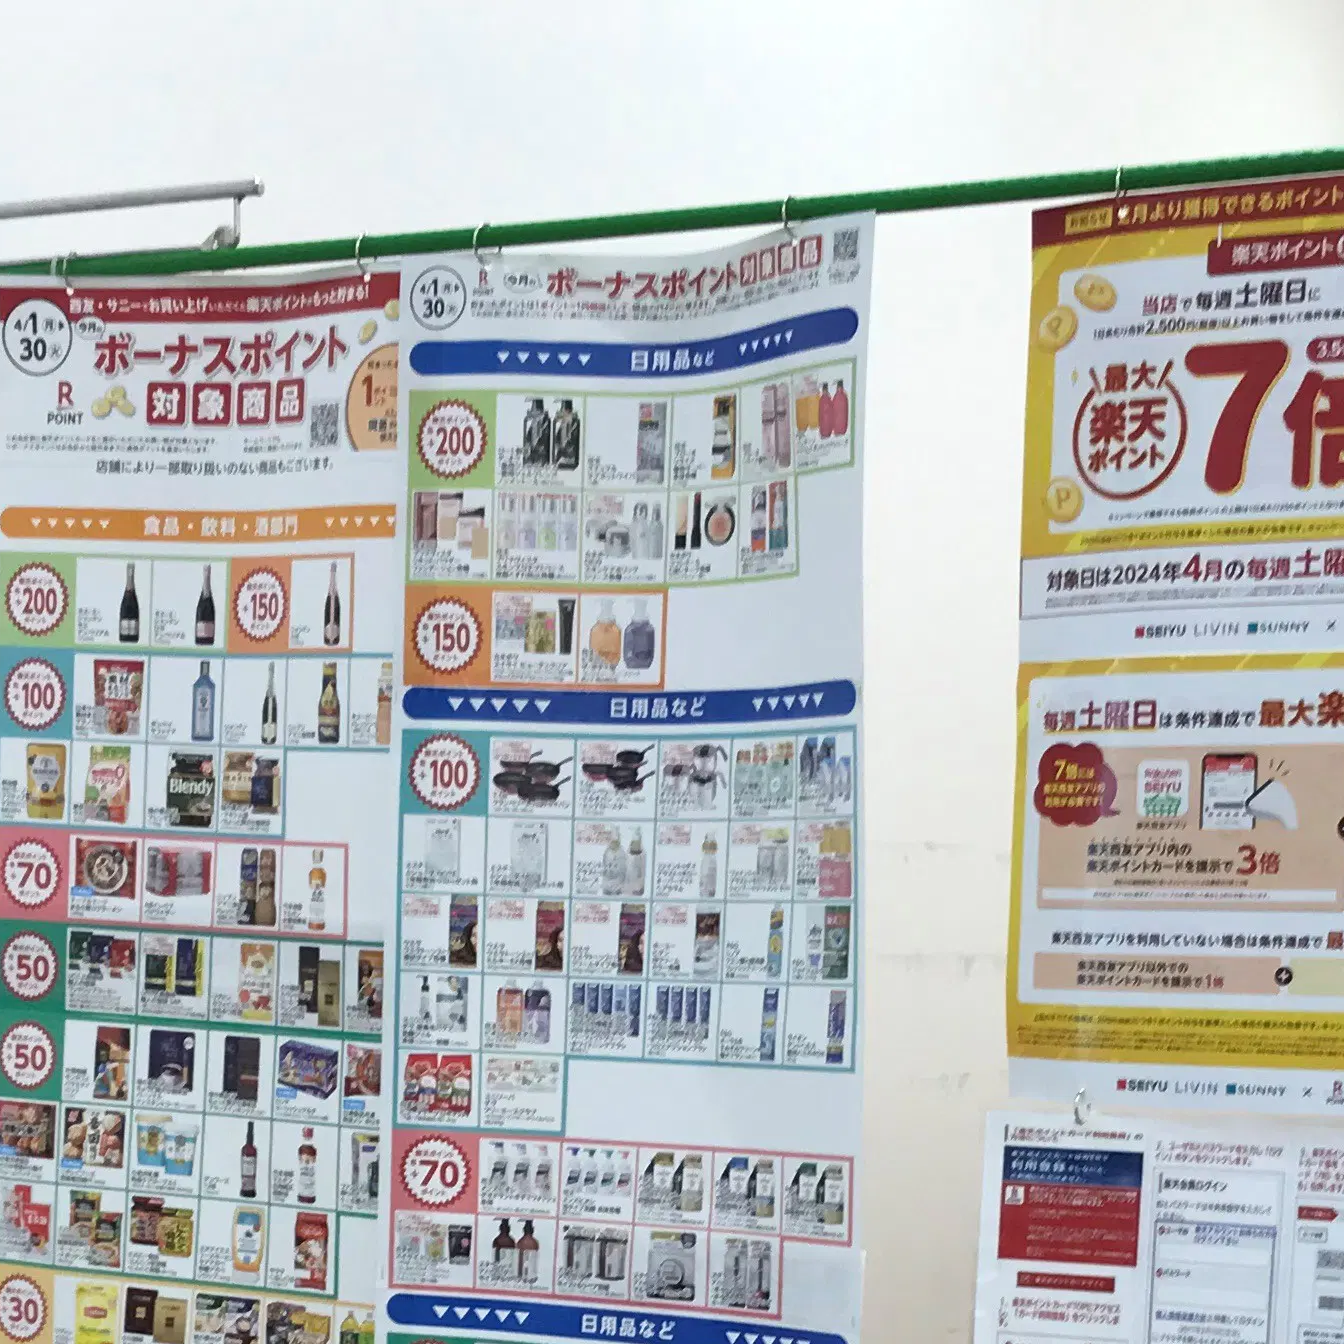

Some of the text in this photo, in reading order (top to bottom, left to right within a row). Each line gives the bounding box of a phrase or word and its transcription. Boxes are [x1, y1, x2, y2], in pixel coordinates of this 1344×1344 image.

[546, 259, 739, 300] ボーナスポイント
[421, 298, 445, 319] 30
[1142, 278, 1321, 316] 当店で毎週土曜日に
[19, 337, 47, 362] 30
[94, 324, 348, 377] ボーナスポイント
[629, 349, 716, 373] 日用品など
[1103, 359, 1158, 394] 最大
[58, 380, 74, 404] R
[150, 382, 301, 422] 対象商品
[46, 410, 84, 426] POINT
[1088, 397, 1169, 447] 楽天
[436, 426, 475, 456] 200
[1087, 445, 1166, 473] ポイント
[22, 587, 58, 616] 200
[250, 591, 279, 623] 150
[432, 622, 471, 652] 150
[1193, 623, 1239, 637] LIVIN
[21, 680, 55, 710] 100
[609, 695, 707, 720] 日用品など
[169, 777, 214, 797] Blendy
[429, 759, 469, 790] 100
[17, 861, 53, 888] 70
[16, 953, 50, 983] 50
[14, 1041, 48, 1071] 50
[1127, 1079, 1168, 1093] SEIYU
[1174, 1081, 1219, 1095] LIVIN
[418, 1159, 460, 1188] 70
[9, 1296, 39, 1326] 30
[580, 1313, 676, 1341] 日用品など
